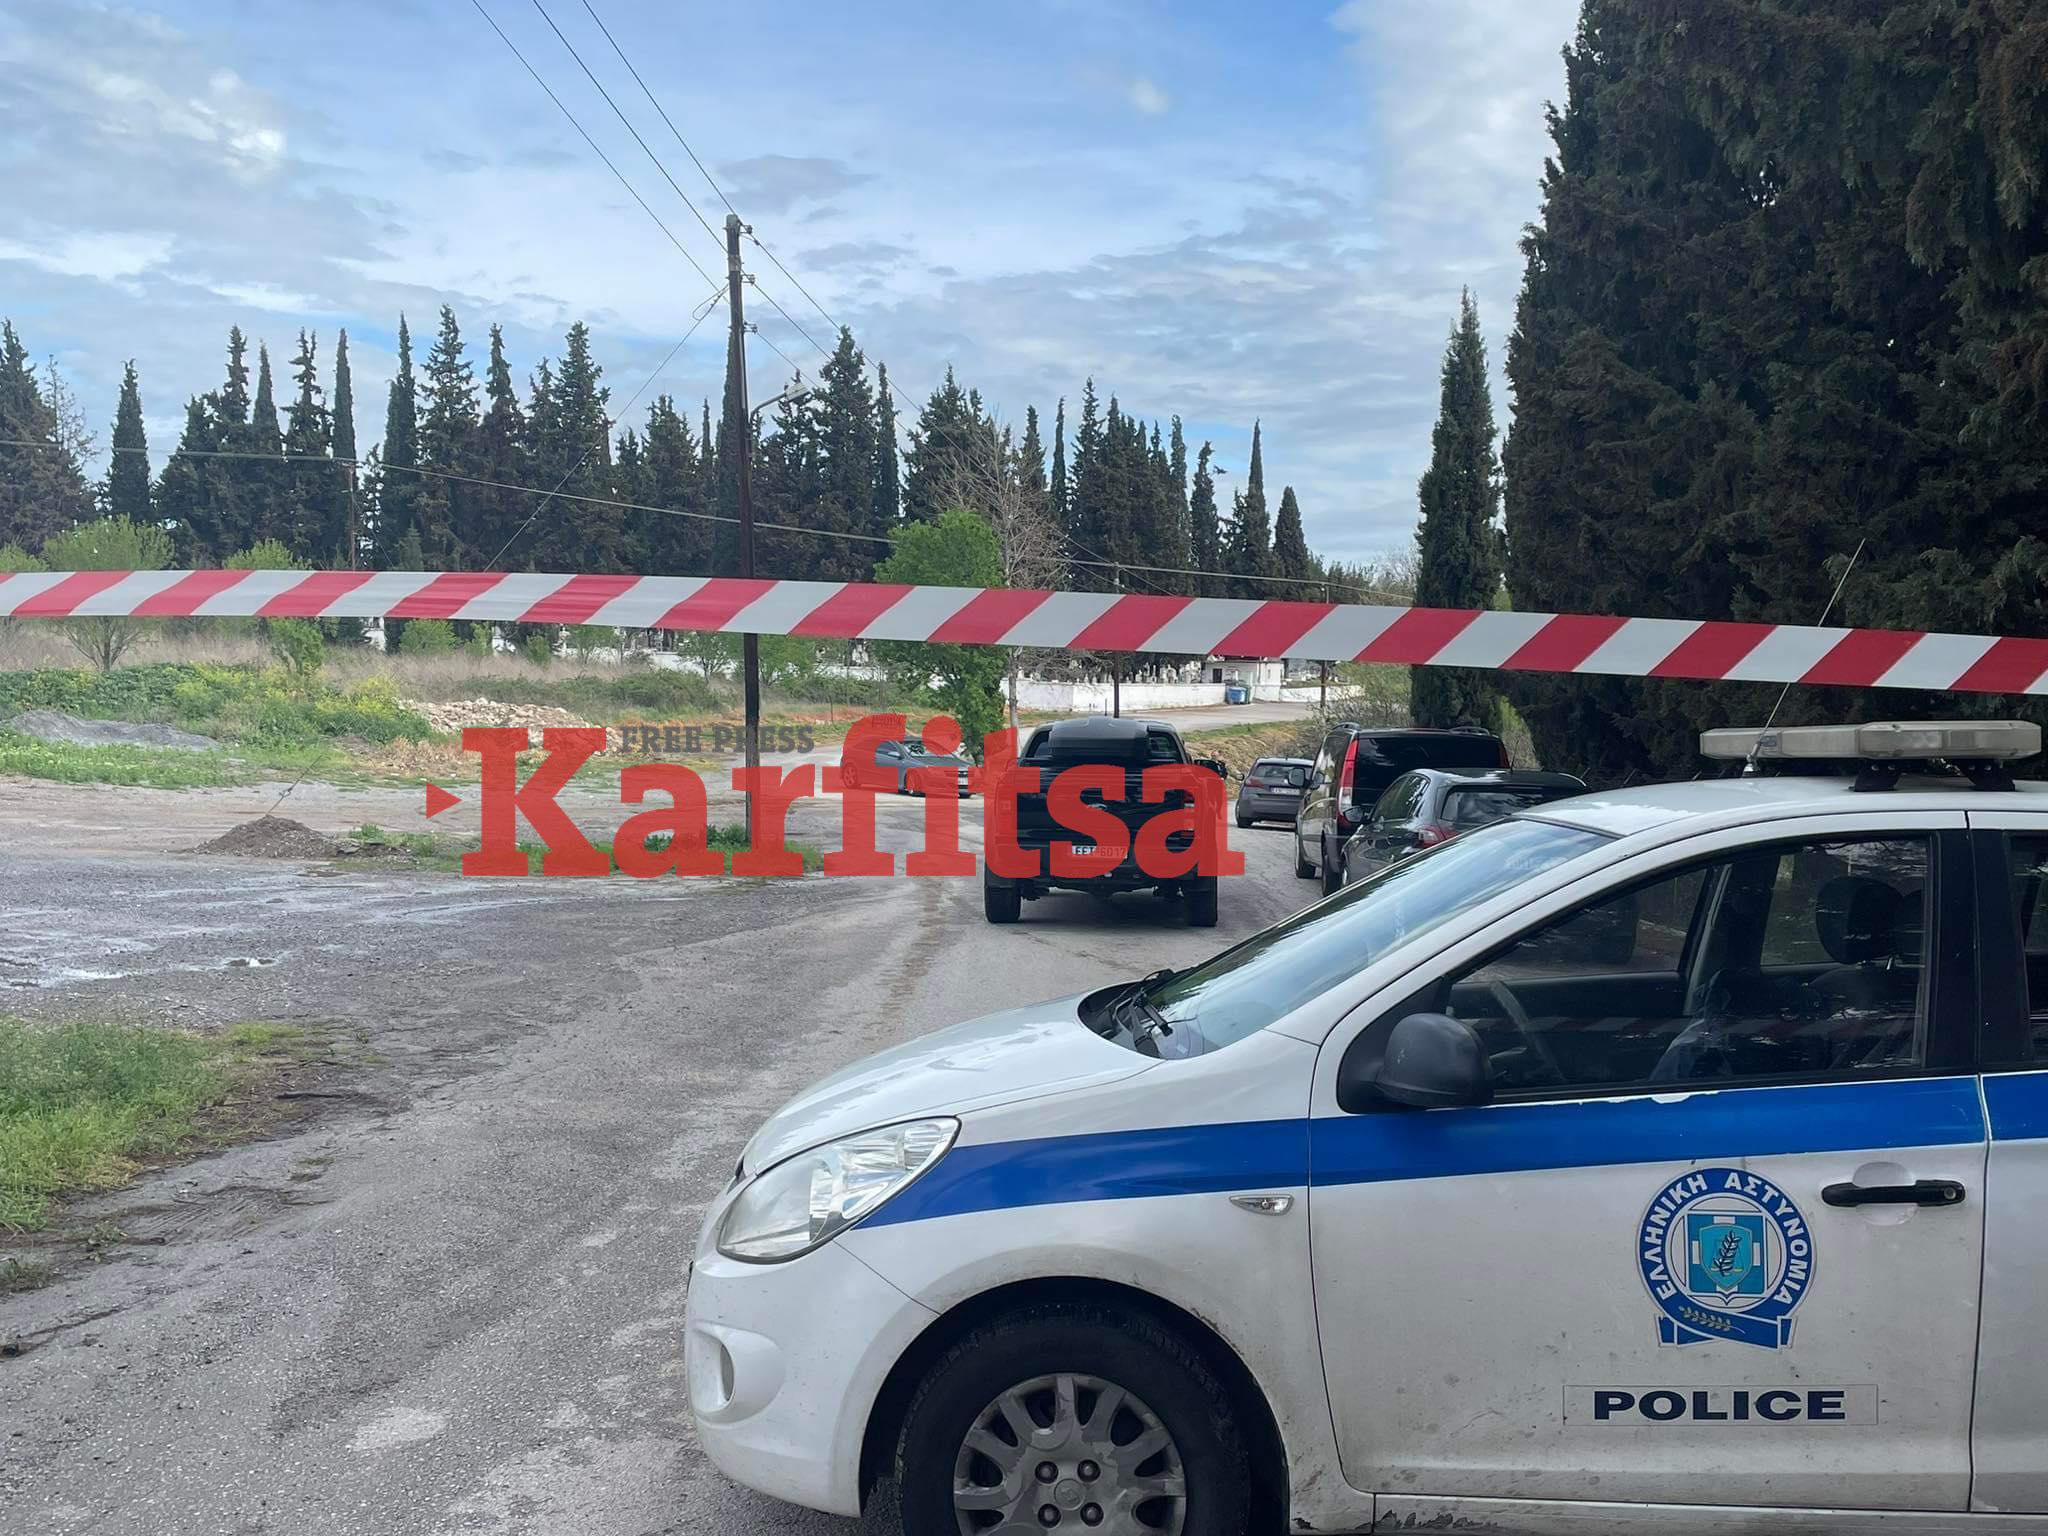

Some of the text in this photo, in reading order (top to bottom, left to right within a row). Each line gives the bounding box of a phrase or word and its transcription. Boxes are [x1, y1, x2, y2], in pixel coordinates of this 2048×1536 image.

[1643, 1172, 1808, 1305] ΕΛΛΗΝΙΚΗ ΑΣΤΥΝΟΜΙΑ
[1593, 1390, 1846, 1421] POLICE
